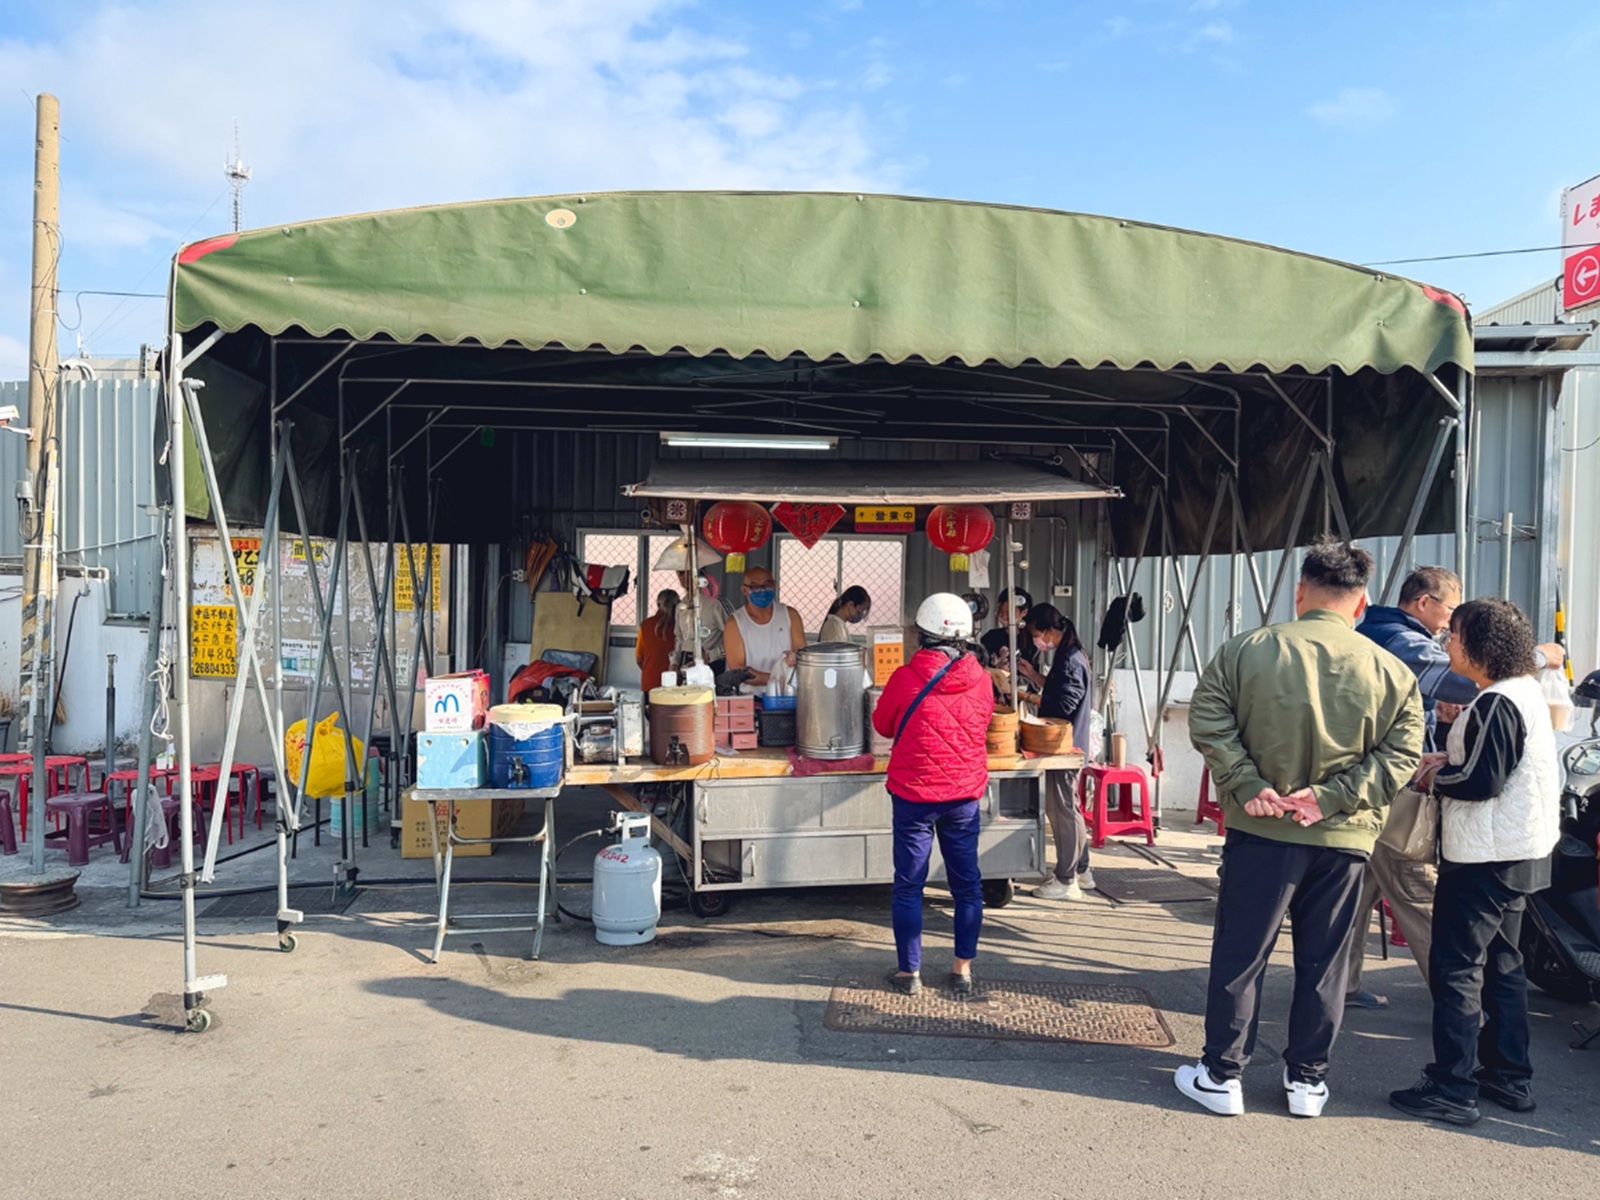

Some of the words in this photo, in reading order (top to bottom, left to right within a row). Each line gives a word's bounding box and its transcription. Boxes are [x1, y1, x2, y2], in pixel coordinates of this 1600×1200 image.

[875, 510, 913, 521] 營業中
[195, 662, 236, 674] 26804333
